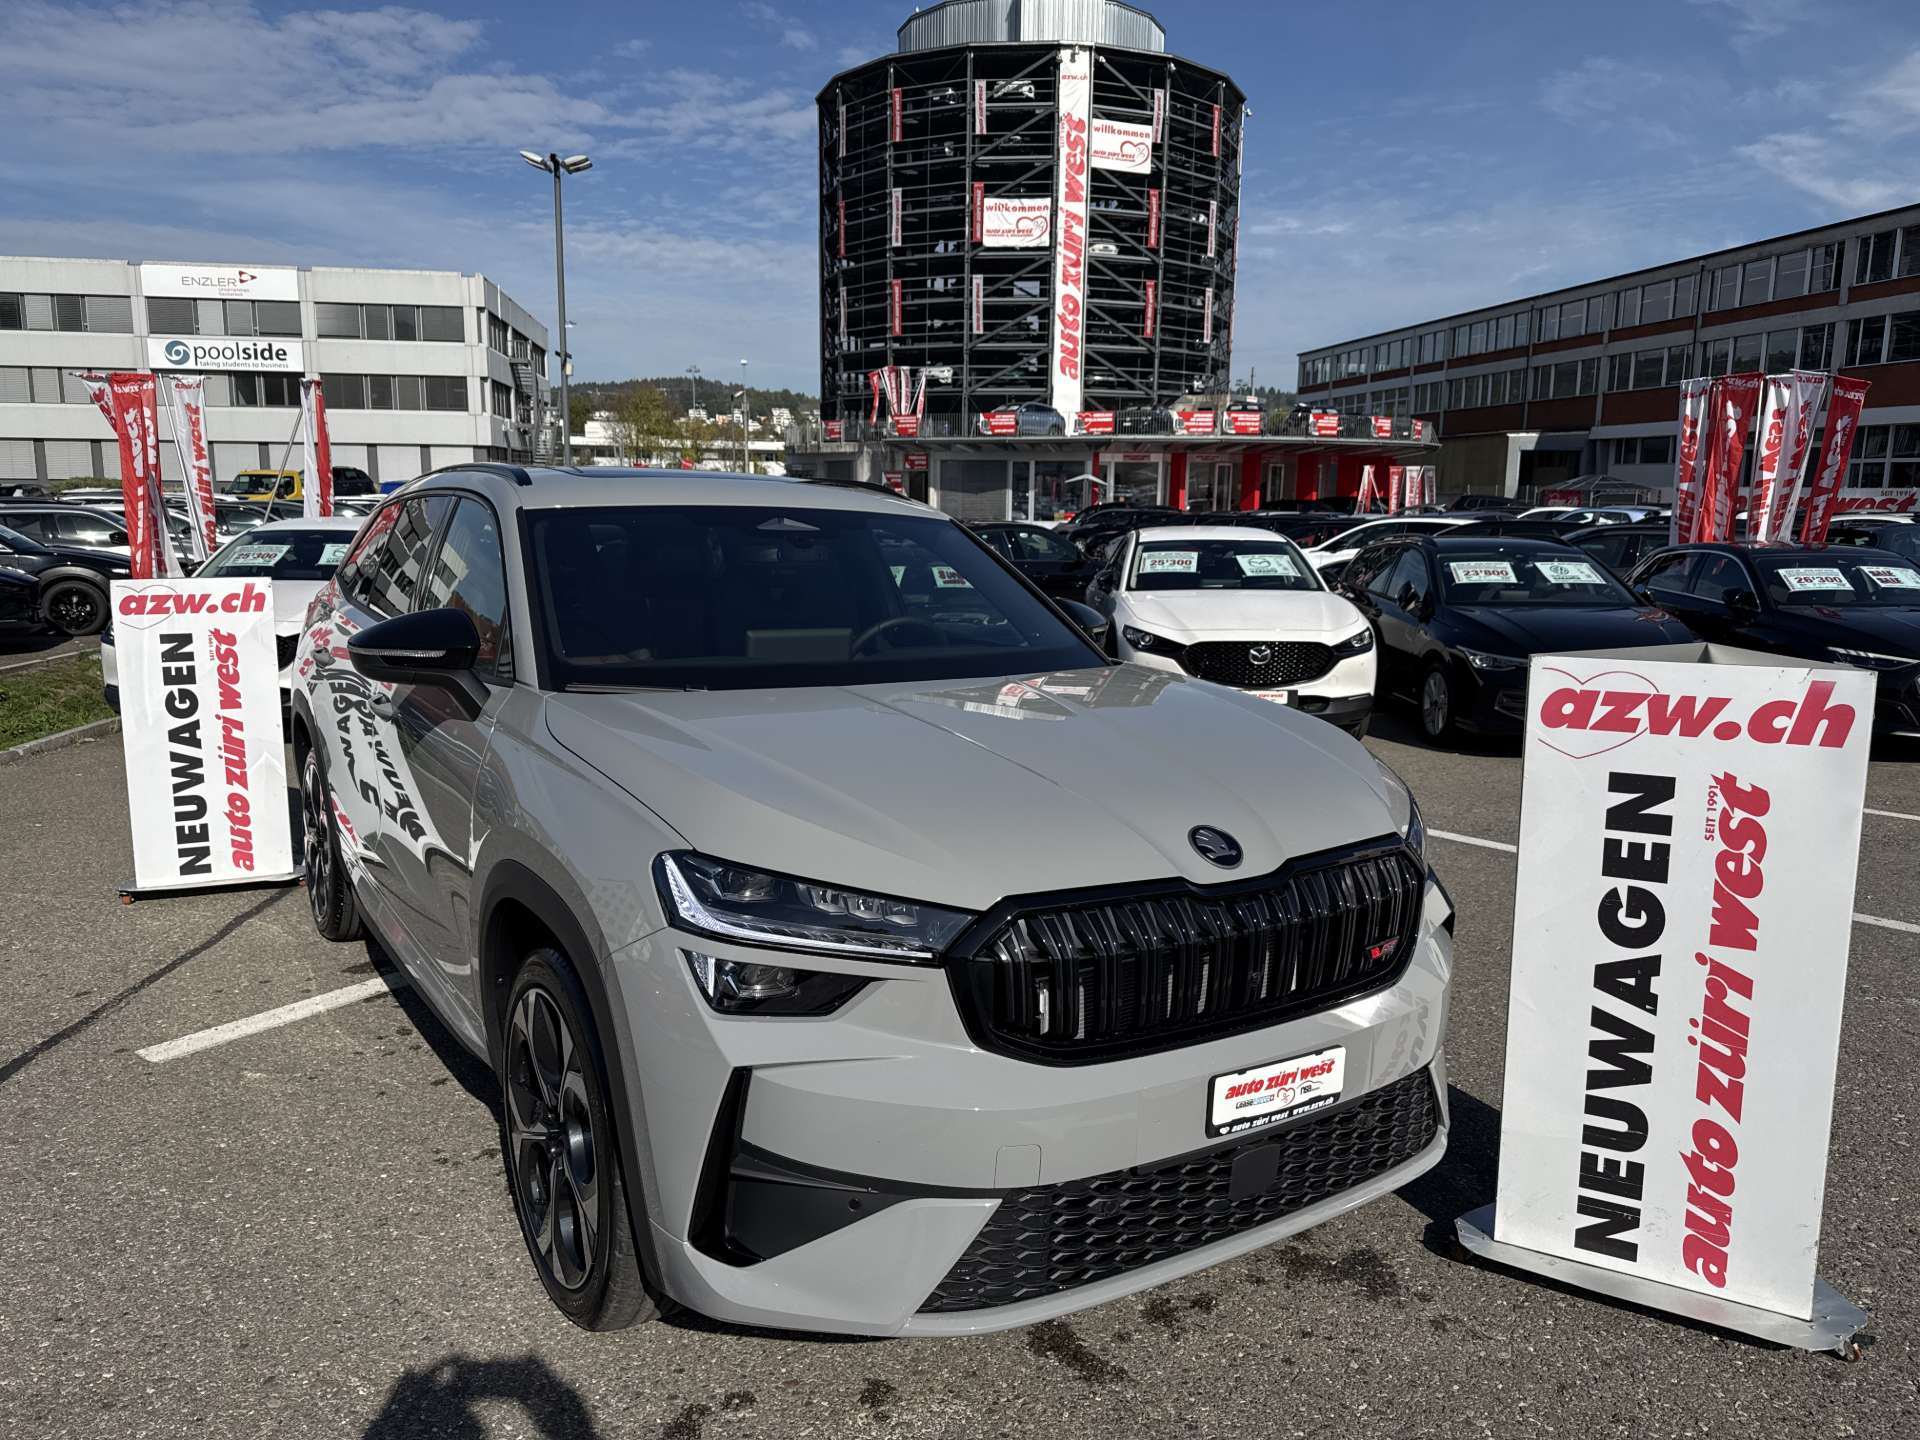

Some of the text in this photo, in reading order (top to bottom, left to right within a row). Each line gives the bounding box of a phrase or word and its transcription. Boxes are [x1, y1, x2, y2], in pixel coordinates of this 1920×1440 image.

[1093, 124, 1151, 139] willkommen
[1057, 112, 1086, 380] auto züri west
[181, 276, 238, 287] ENZLER
[193, 341, 288, 367] poolside
[200, 361, 221, 369] taking
[223, 361, 250, 369] students
[184, 402, 207, 462] west
[1150, 558, 1193, 567] 25'300
[1463, 569, 1509, 577] 23'800
[1795, 576, 1843, 584] 26'300
[119, 583, 266, 615] azw.ch
[1540, 680, 1857, 749] azw.ch
[159, 633, 212, 876] NEUWAGEN
[209, 628, 255, 872] auto züri west
[1704, 785, 1719, 841] SEIT 1991
[1573, 771, 1677, 1263] NEUWAGEN
[1681, 771, 1771, 1289] auto züri west
[1225, 1060, 1336, 1100] auto züri west
[1231, 1121, 1251, 1132] auto
[1252, 1115, 1270, 1126] züri
[1271, 1110, 1289, 1122] west
